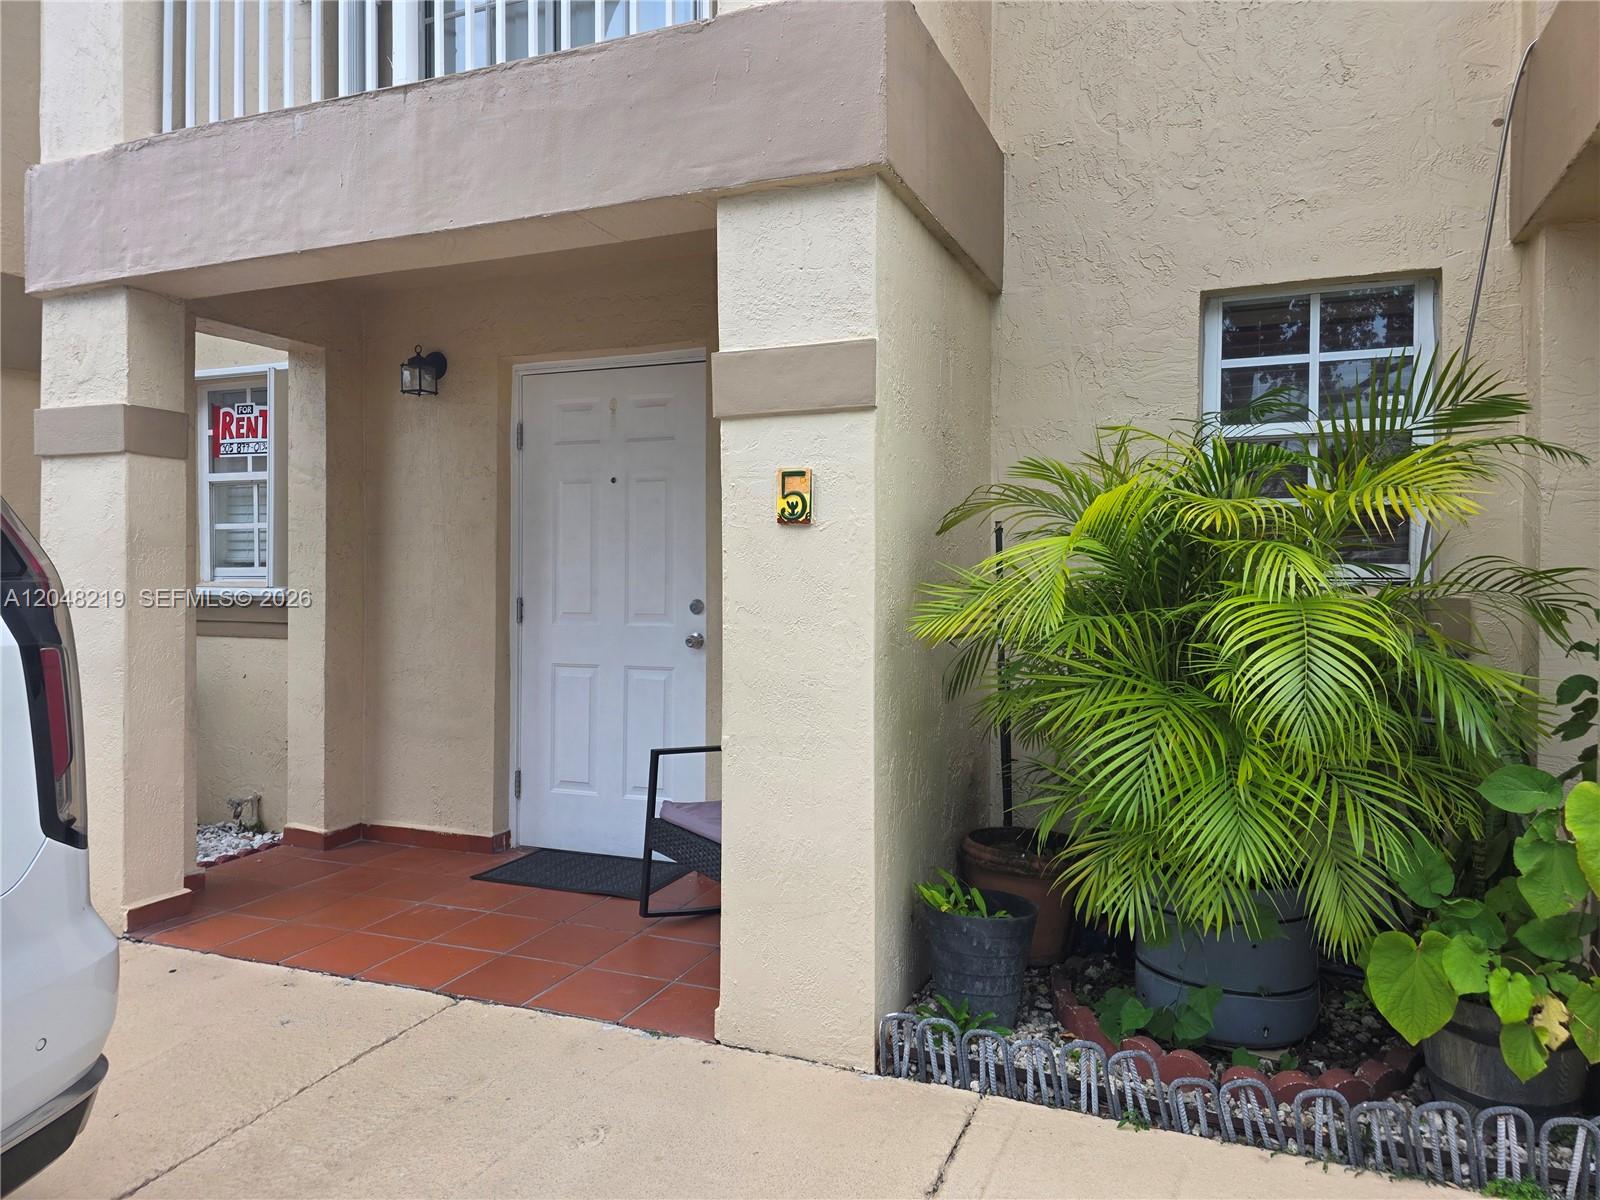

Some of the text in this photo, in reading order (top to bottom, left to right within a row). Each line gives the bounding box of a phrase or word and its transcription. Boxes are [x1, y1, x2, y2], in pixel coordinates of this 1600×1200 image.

[220, 409, 267, 440] RENT
[237, 405, 253, 414] FOR
[780, 471, 808, 520] 5
